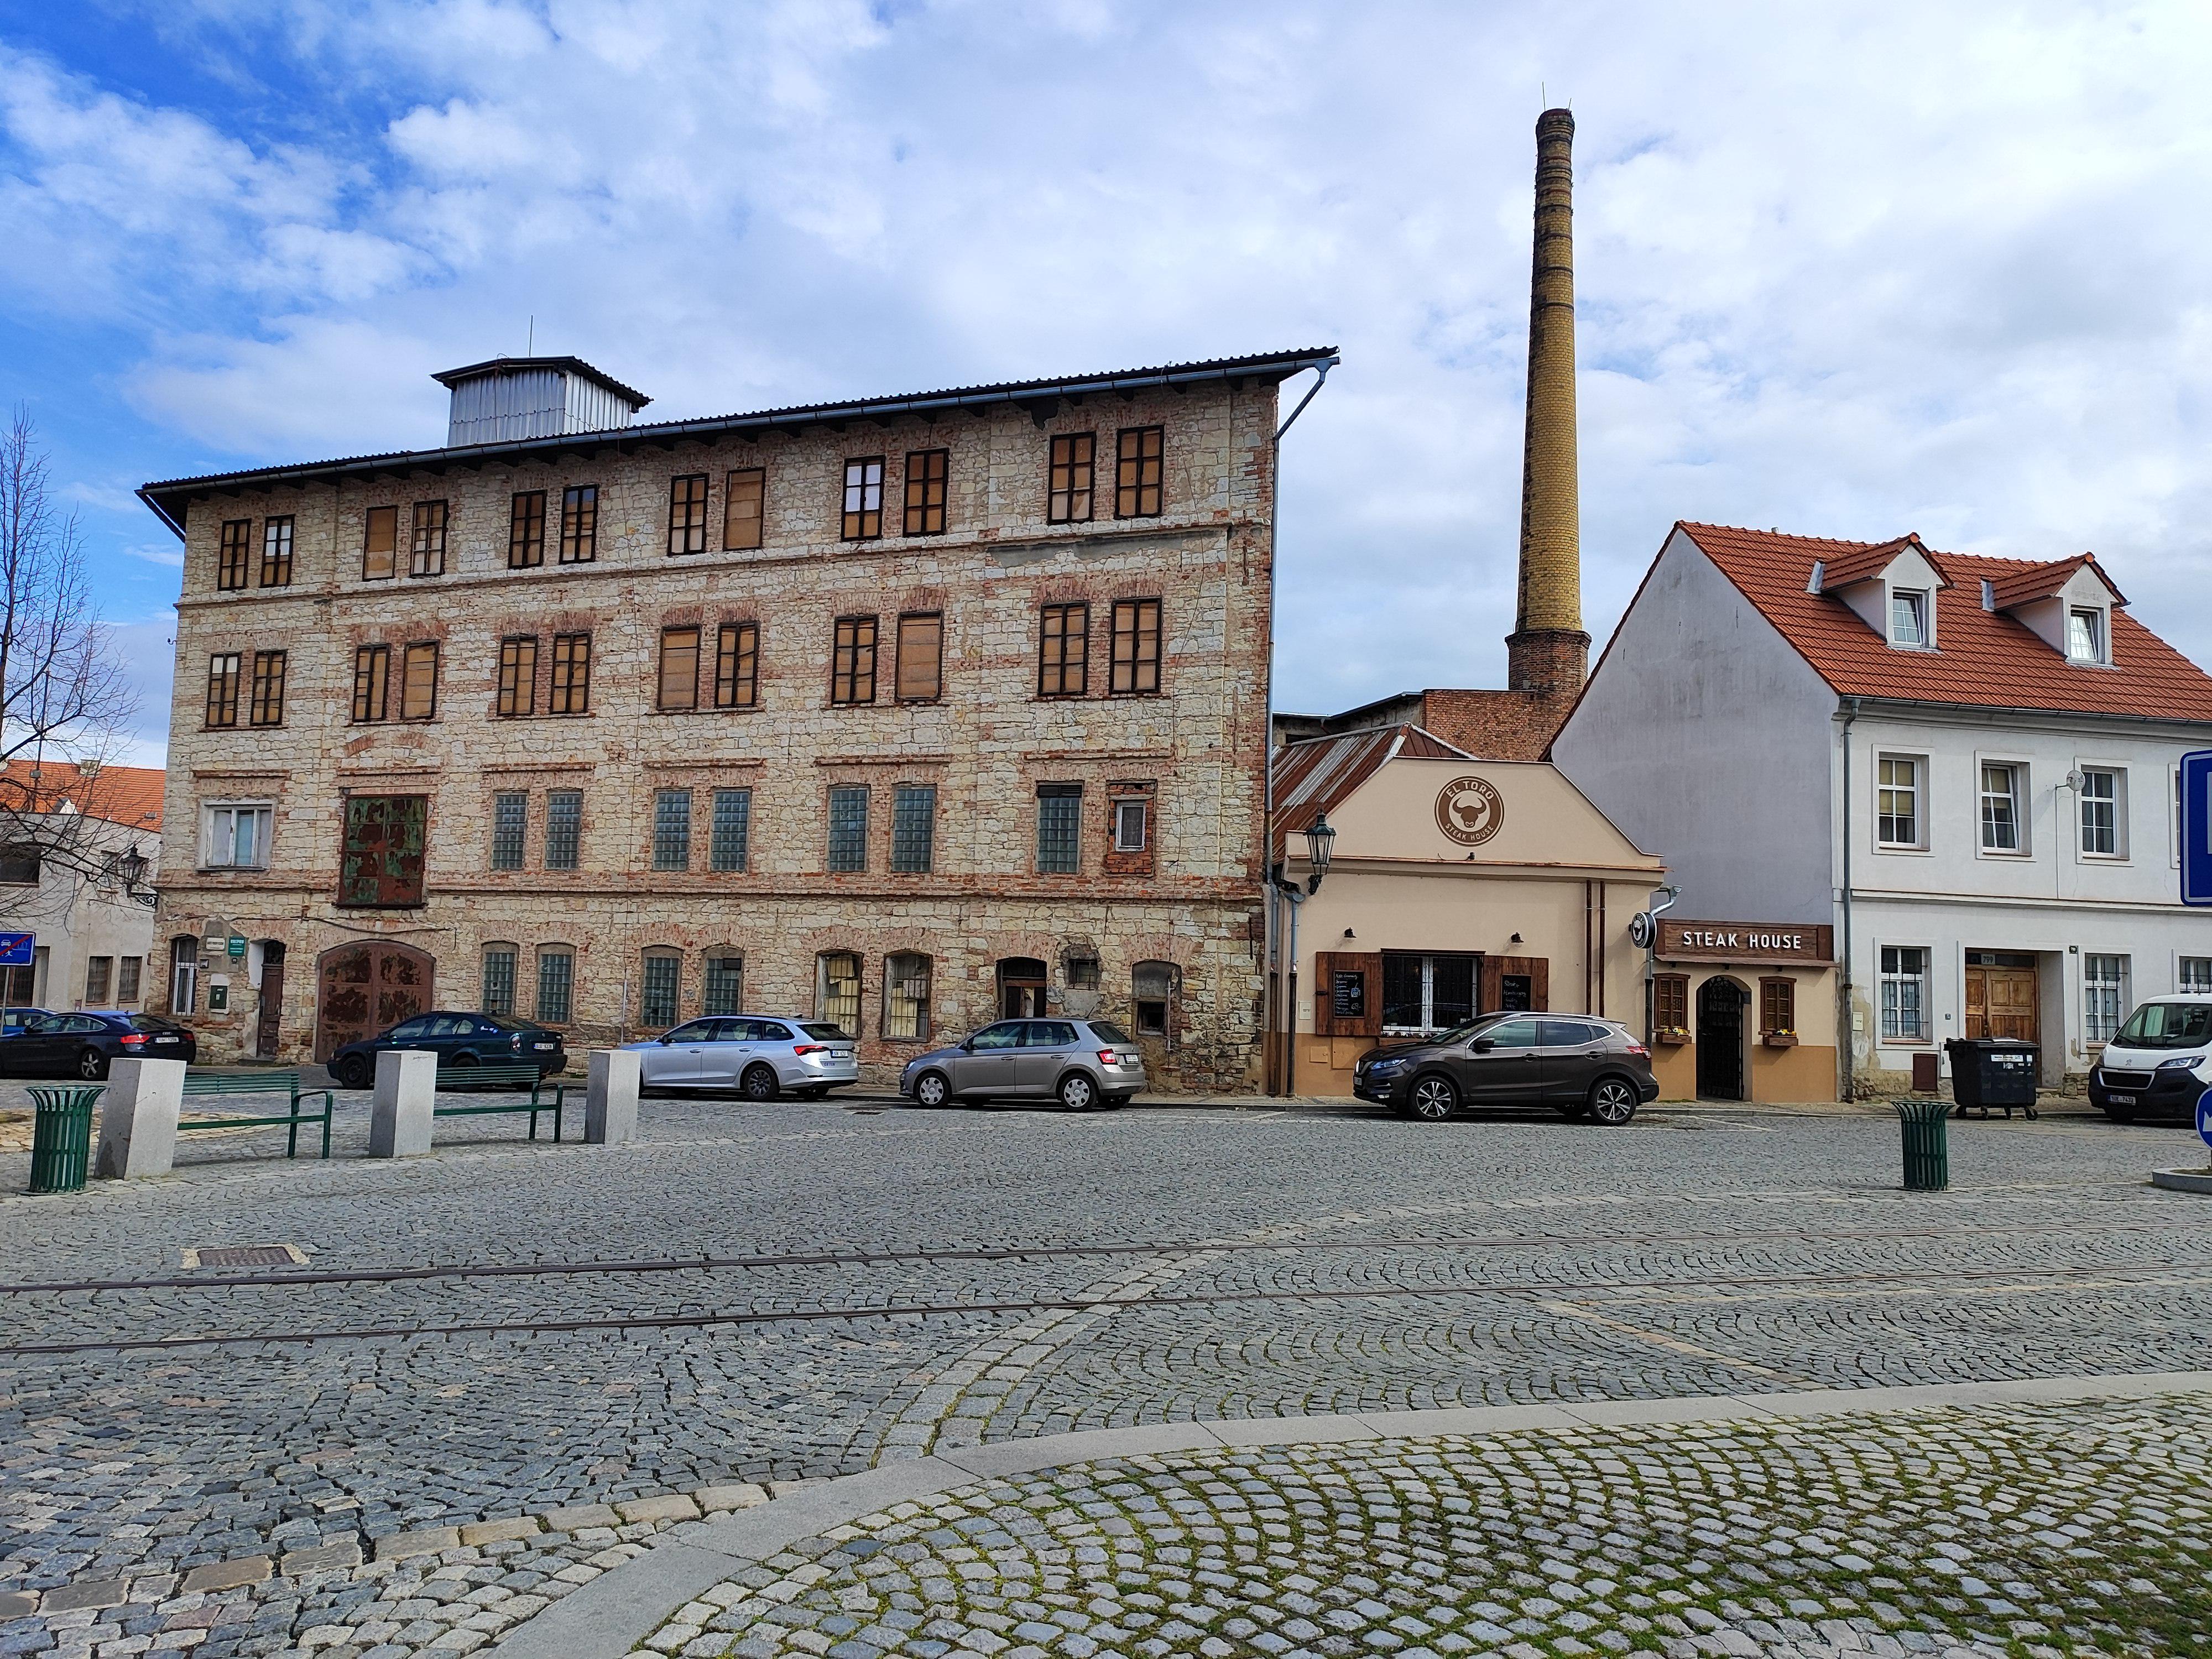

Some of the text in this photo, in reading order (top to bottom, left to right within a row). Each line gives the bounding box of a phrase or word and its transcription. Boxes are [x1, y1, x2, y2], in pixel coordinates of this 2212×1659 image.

[1446, 781, 1494, 800] EL TORO
[1445, 823, 1494, 841] STEAK HOUSE
[1683, 931, 1802, 950] STEAK HOUSE
